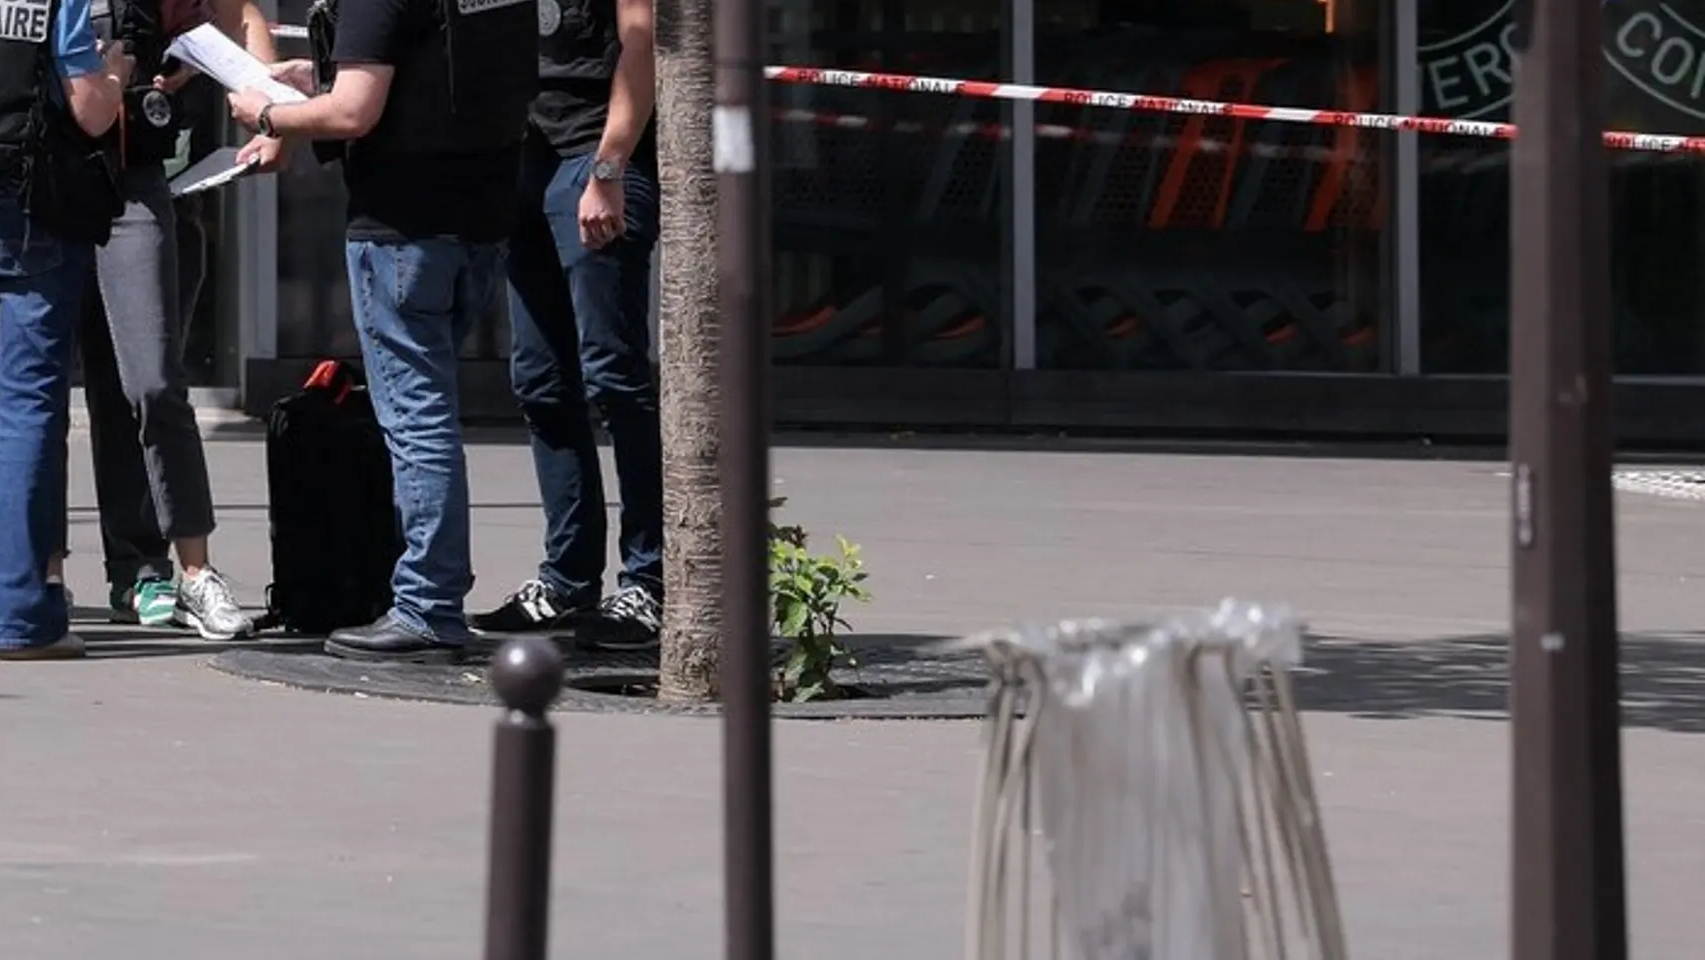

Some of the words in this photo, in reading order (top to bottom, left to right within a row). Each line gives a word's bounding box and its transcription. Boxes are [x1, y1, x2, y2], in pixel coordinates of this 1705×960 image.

[798, 70, 861, 87] POLICE
[867, 75, 965, 93] NATIONALE
[1064, 92, 1127, 107] POLICE
[1133, 98, 1233, 115] NATIONALE
[1334, 114, 1394, 129] POLICE
